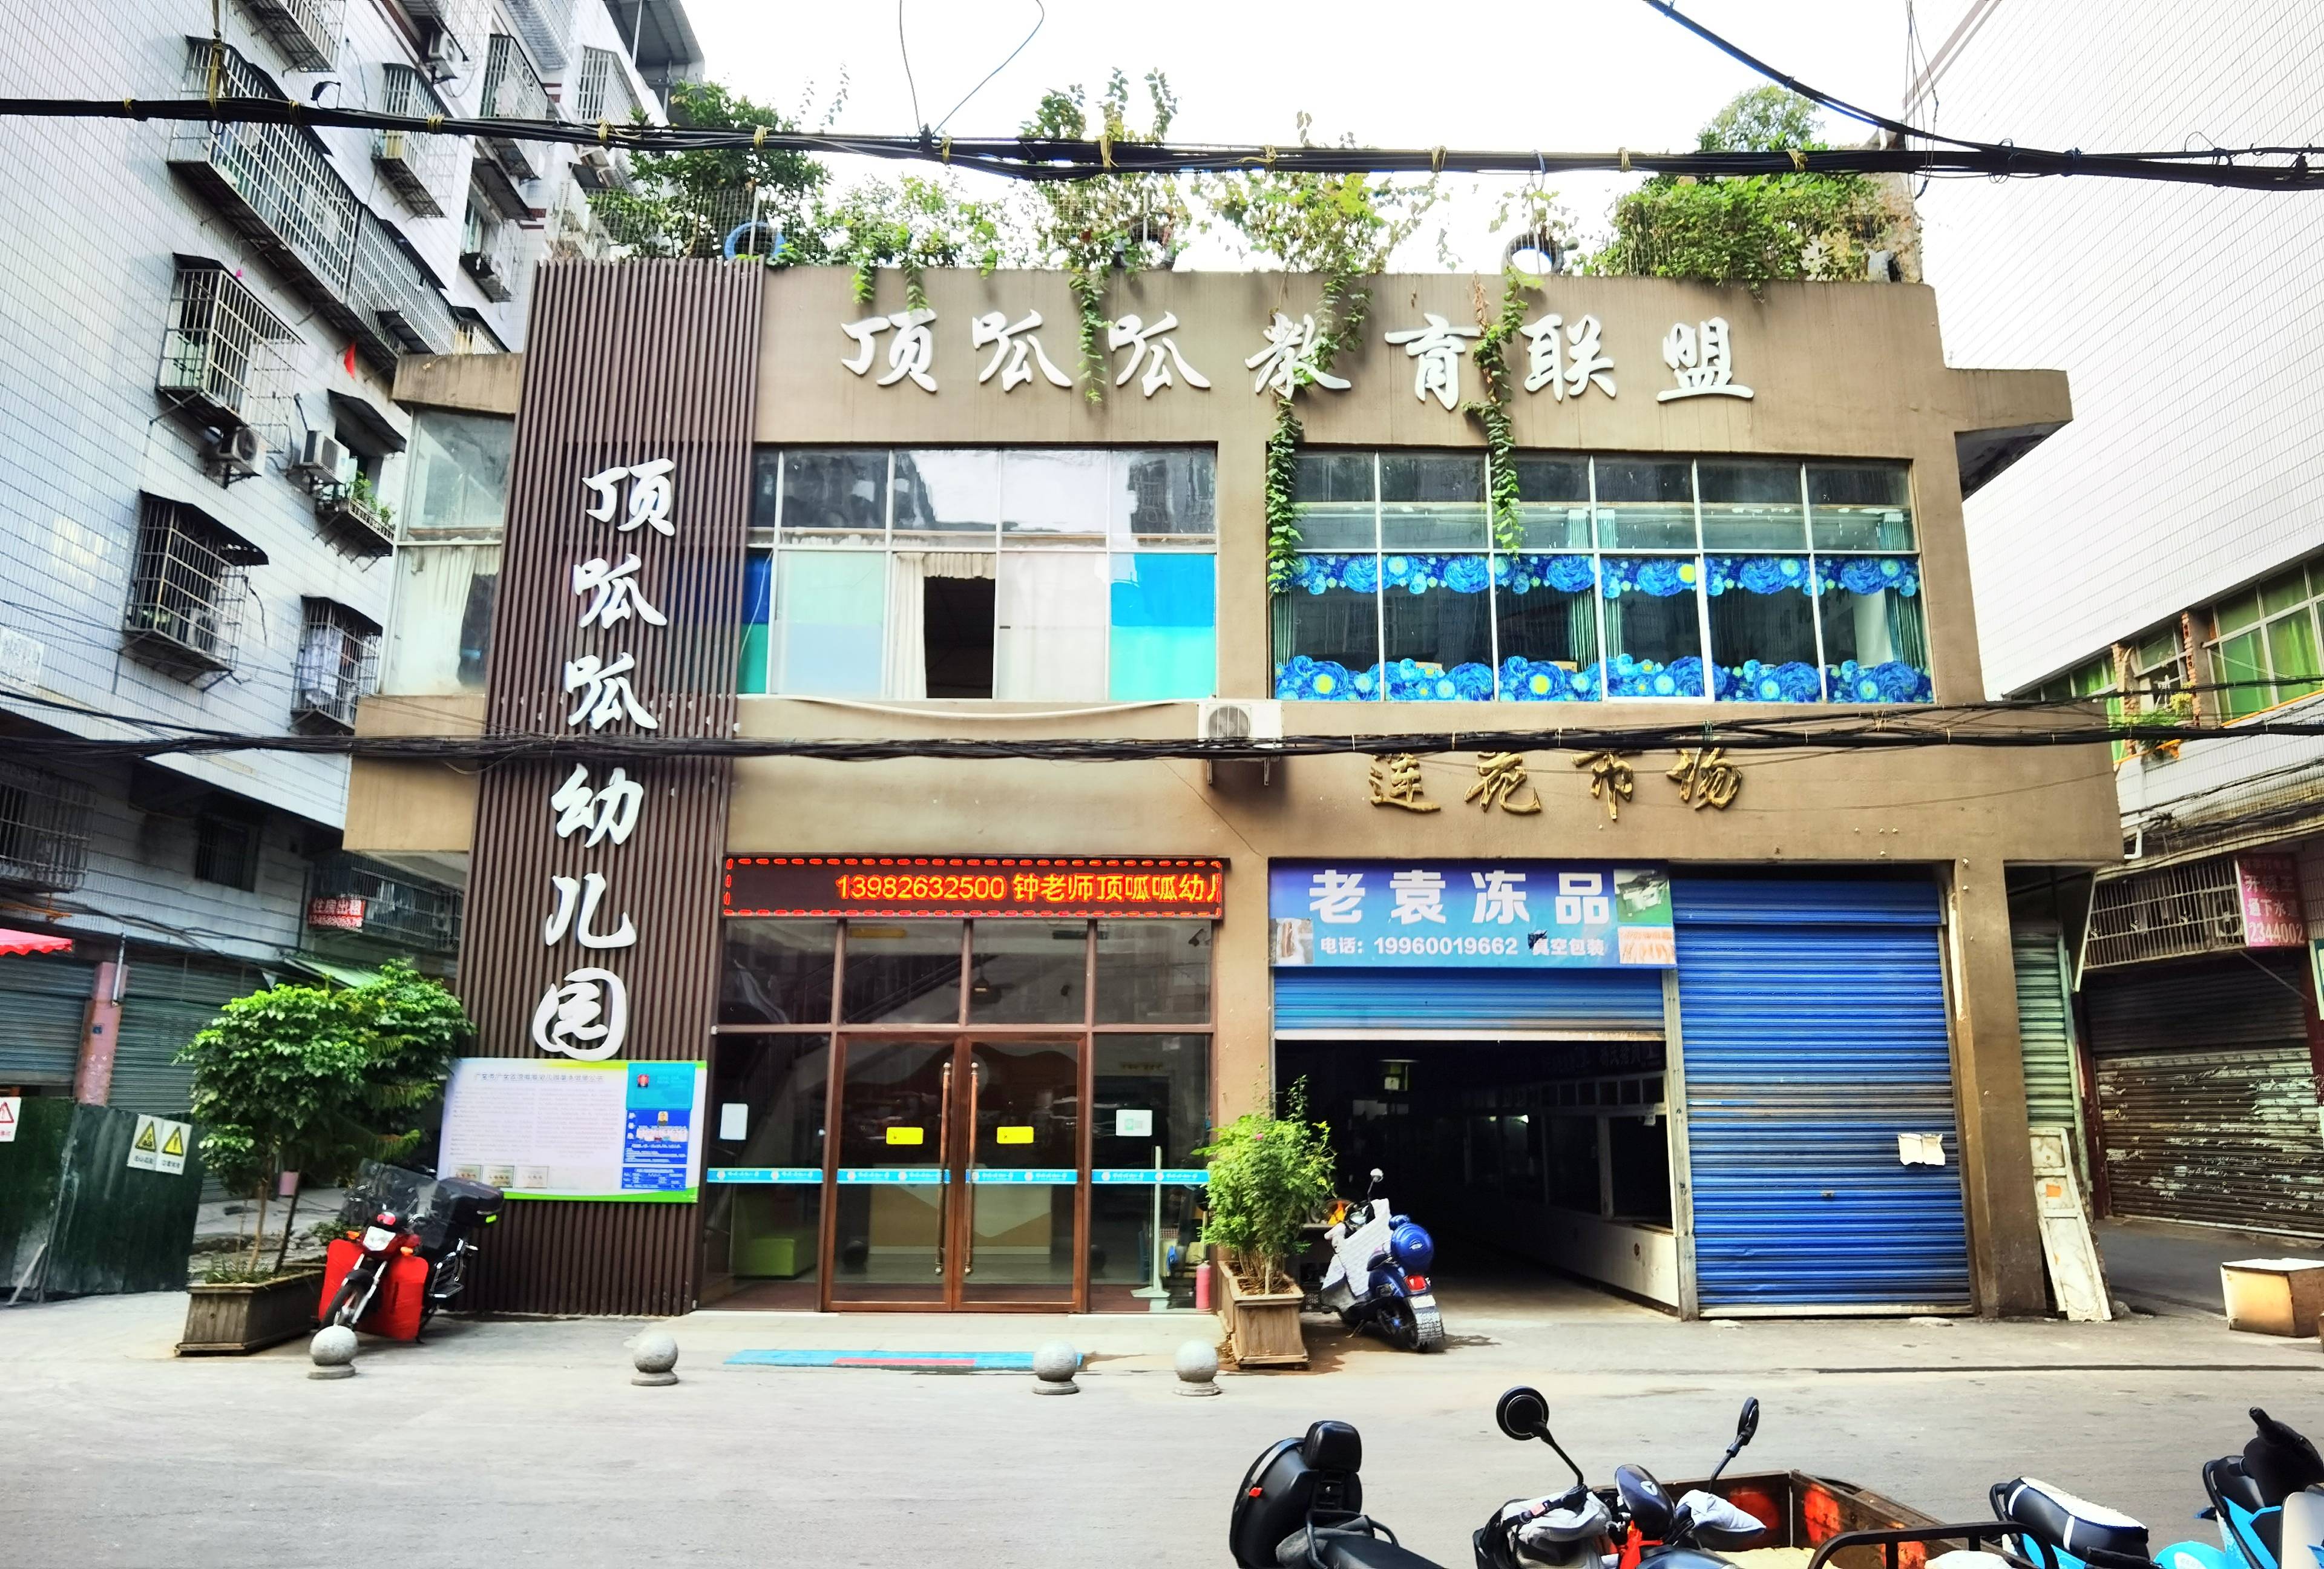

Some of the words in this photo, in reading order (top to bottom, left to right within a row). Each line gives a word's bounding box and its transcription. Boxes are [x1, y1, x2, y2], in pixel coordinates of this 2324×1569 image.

[840, 308, 1754, 410] 顶呱呱教育联盟
[532, 458, 675, 1061] 顶呱呱幼儿园
[836, 873, 1006, 902] 13982632500
[1308, 869, 1610, 925] 老袁冻品
[1373, 936, 1518, 955] 19960019662
[2248, 921, 2305, 944] 2344002
